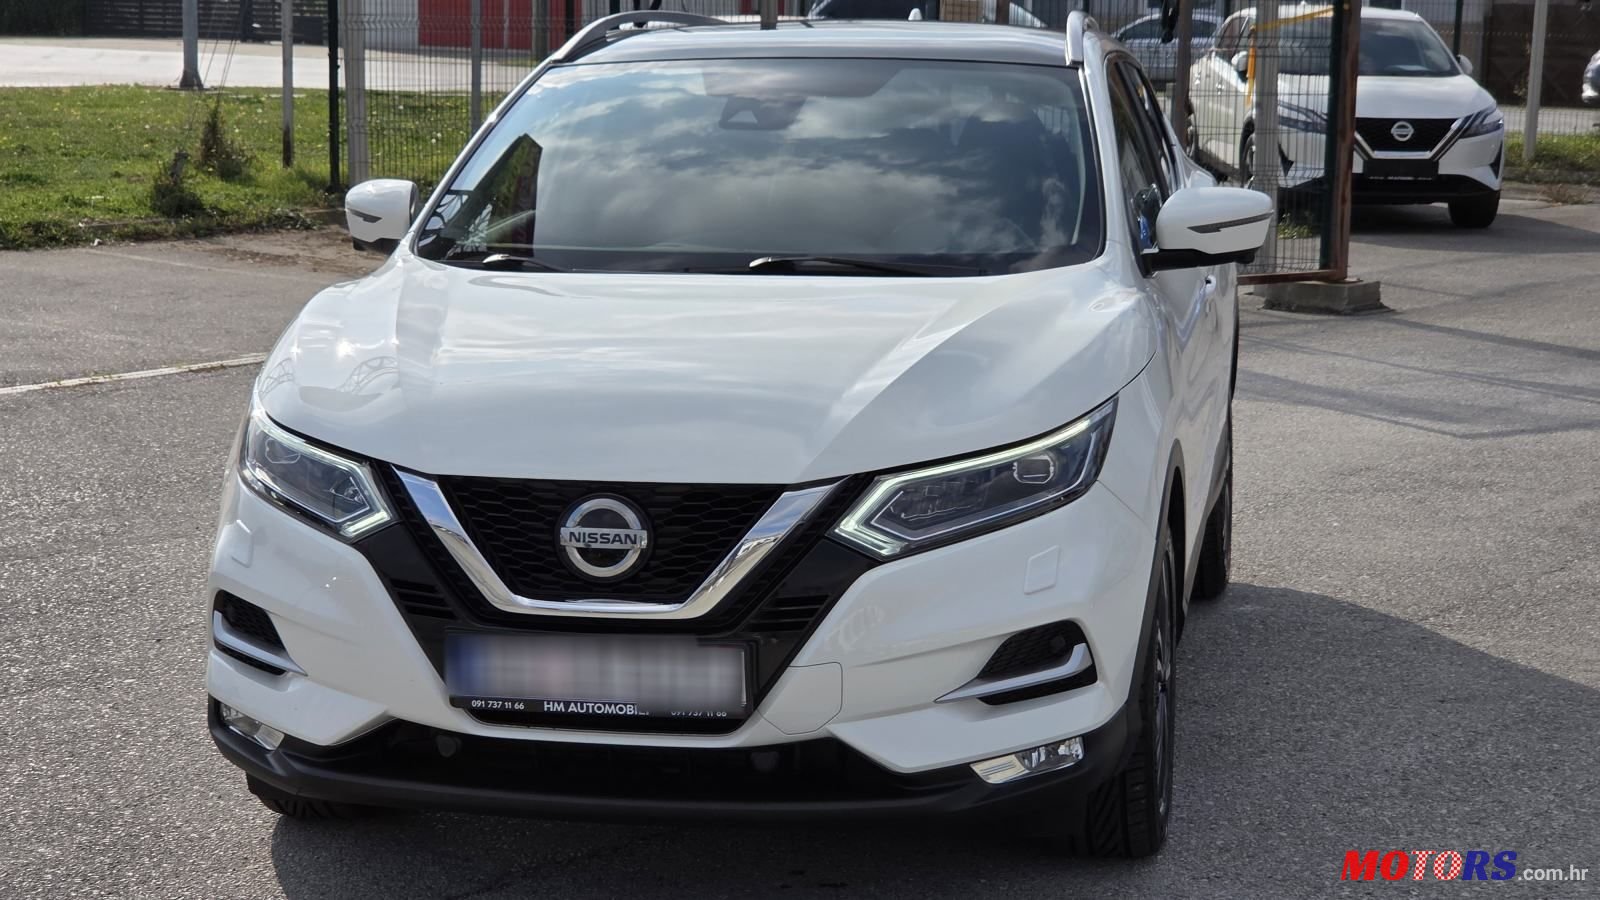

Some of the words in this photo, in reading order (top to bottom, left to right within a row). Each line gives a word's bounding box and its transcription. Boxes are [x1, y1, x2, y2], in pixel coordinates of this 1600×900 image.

[568, 531, 637, 545] NISSAN
[471, 699, 485, 708] 091
[487, 700, 502, 709] 737
[504, 701, 512, 709] 11
[514, 702, 525, 710] 66
[543, 701, 565, 713] HM
[567, 702, 650, 716] AUTOMOBI
